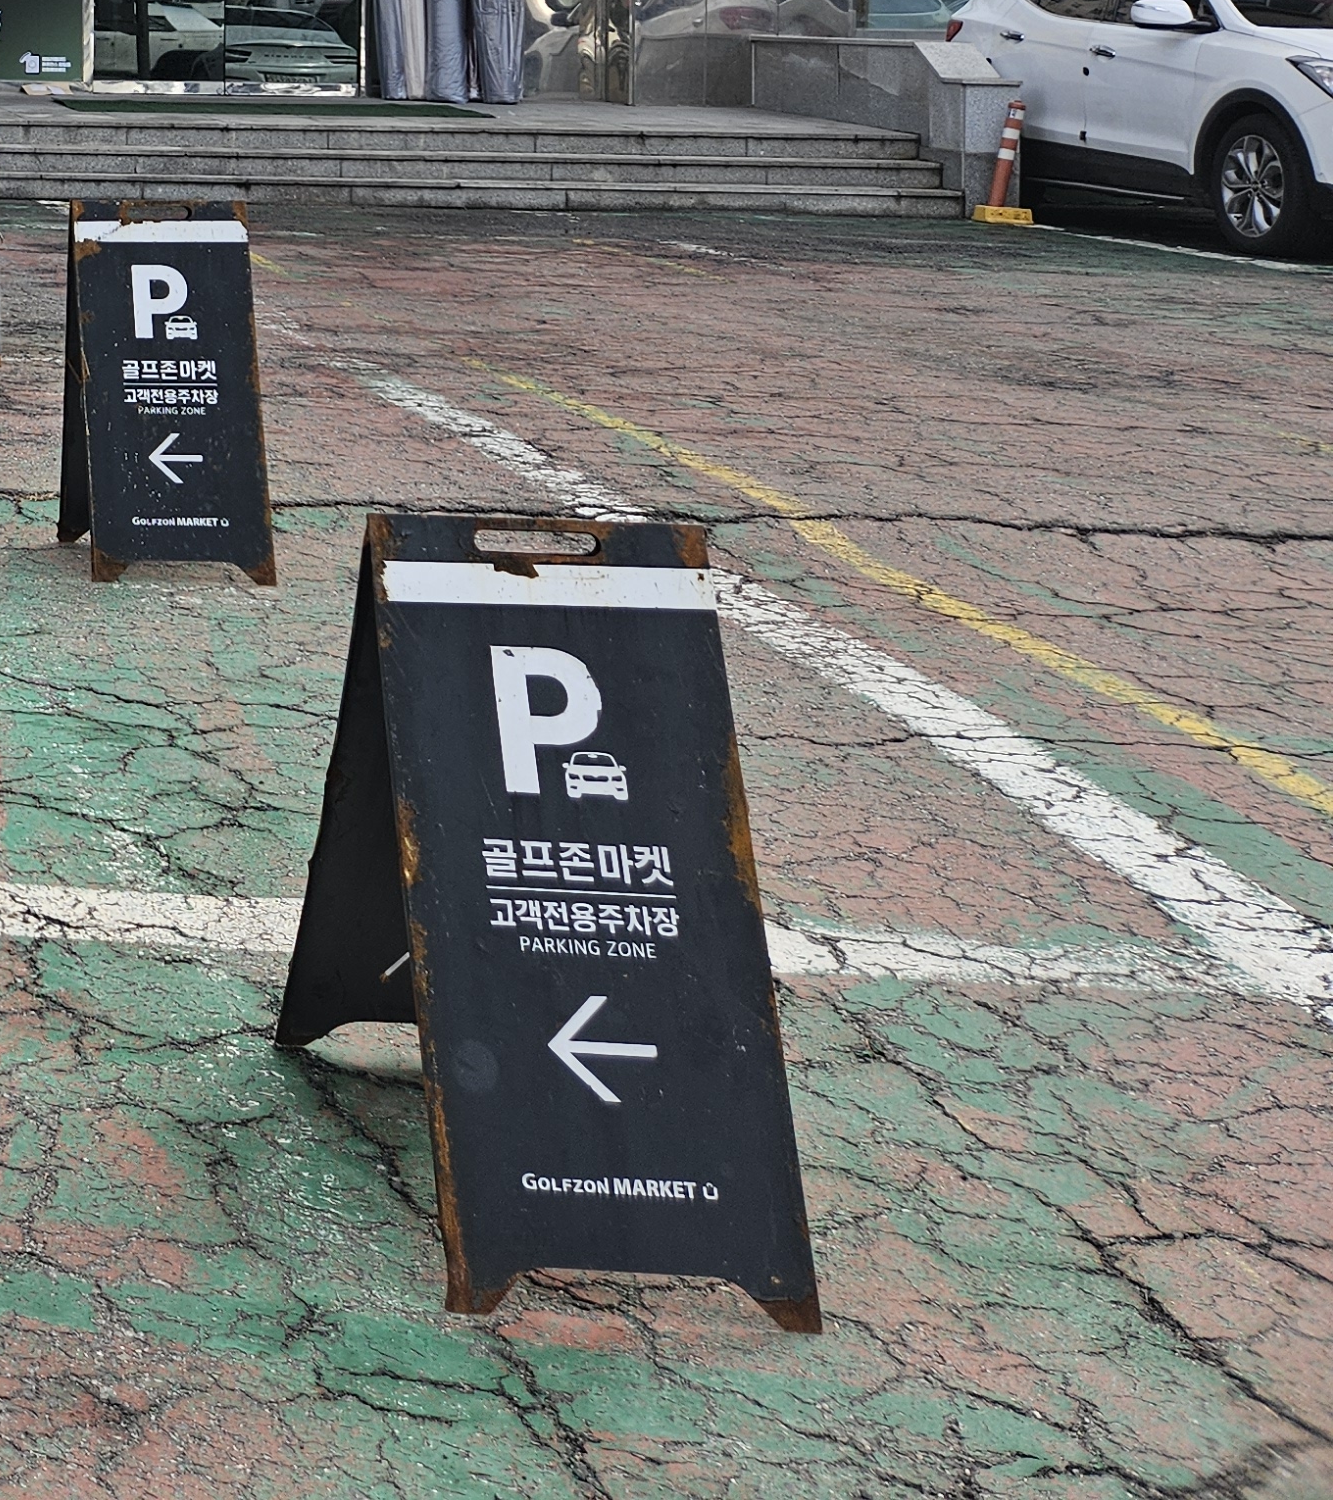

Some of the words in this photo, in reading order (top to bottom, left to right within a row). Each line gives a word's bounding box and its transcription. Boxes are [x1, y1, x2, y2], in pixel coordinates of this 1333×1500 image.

[130, 264, 188, 339] P
[121, 359, 218, 381] 골프존마켓
[123, 388, 219, 404] 고객전용주차장
[137, 405, 179, 415] PARKING
[181, 406, 206, 415] ZONE
[176, 517, 218, 527] MARKET
[490, 645, 602, 794] P
[482, 837, 675, 888] 골프존마켓
[490, 899, 680, 937] 고객전용주차장
[519, 936, 600, 958] PARKING
[607, 941, 657, 960] ZONE
[521, 1172, 610, 1197] GOLFZON
[613, 1179, 697, 1200] MARKET
